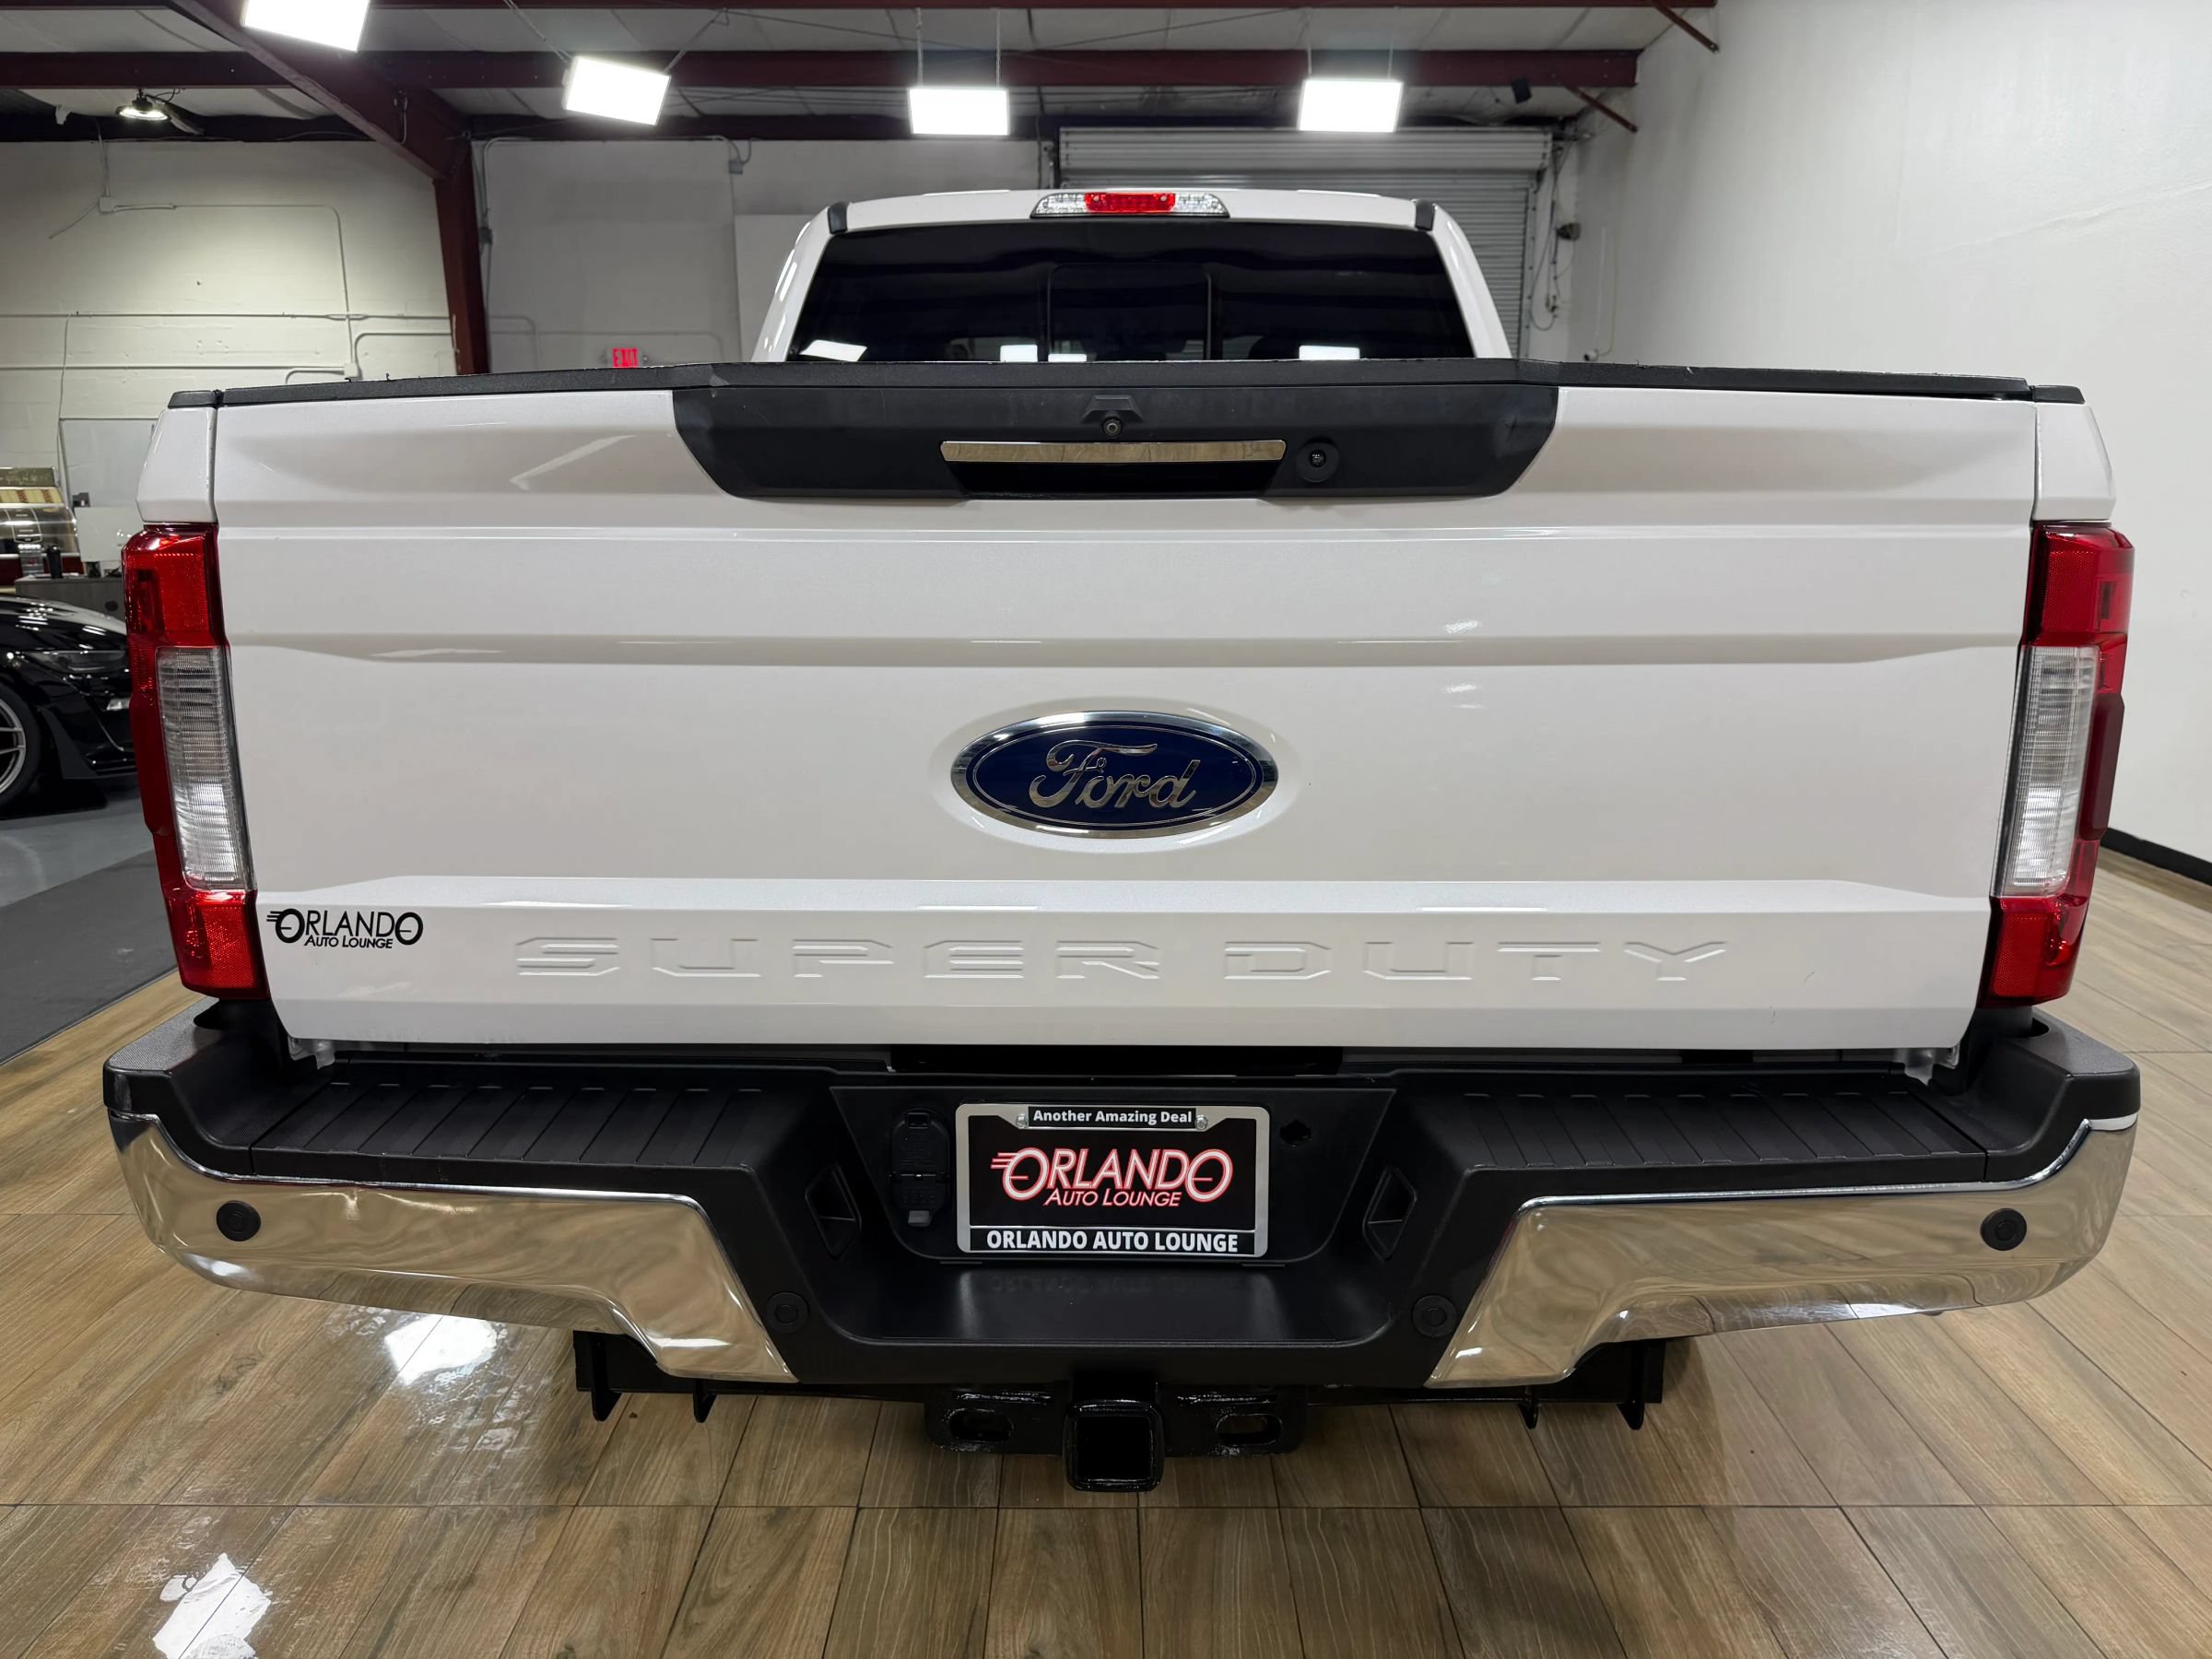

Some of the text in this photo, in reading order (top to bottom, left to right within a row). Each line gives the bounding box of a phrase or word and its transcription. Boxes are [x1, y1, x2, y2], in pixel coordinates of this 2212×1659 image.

[1029, 739, 1201, 808] Ford
[266, 908, 424, 946] ORLANDO
[303, 935, 394, 948] AUTO LOUNGE
[515, 936, 1728, 982] SUPER DUTY
[1033, 1110, 1192, 1125] Another Amazing Deal
[991, 1147, 1233, 1202] ORLANDO
[1043, 1187, 1182, 1207] AUTO LOUNGE
[986, 1230, 1238, 1253] ORLANDO AUTO LOUNGE
